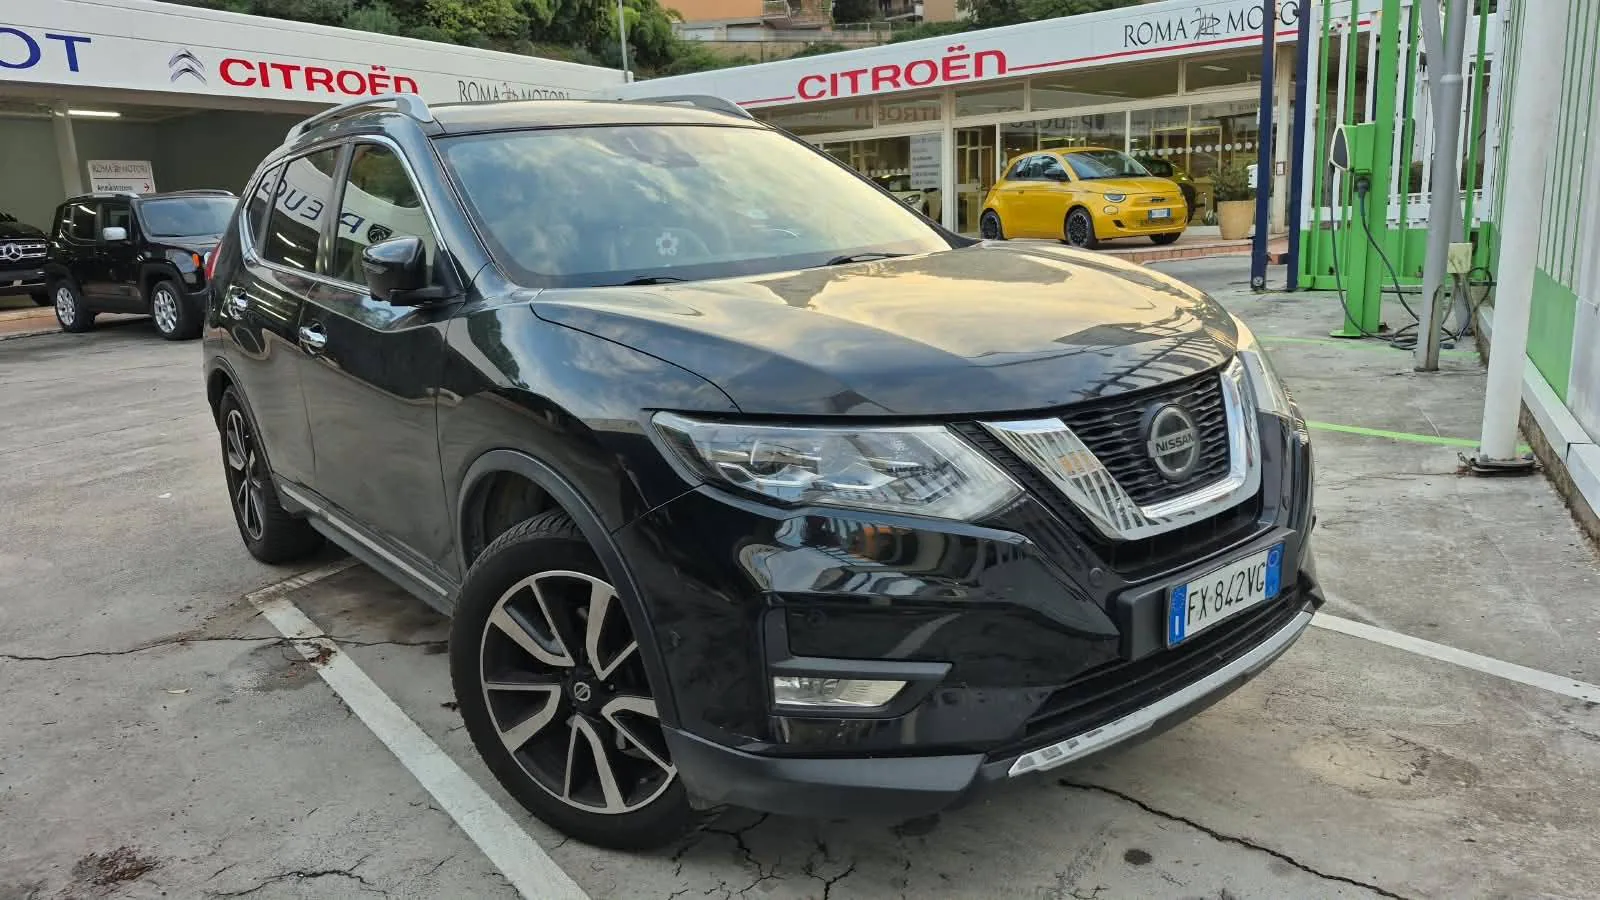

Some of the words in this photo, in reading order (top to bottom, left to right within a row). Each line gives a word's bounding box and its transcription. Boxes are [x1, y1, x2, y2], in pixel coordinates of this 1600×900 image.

[1124, 17, 1187, 47] ROMA
[458, 80, 500, 102] ROMA
[1155, 433, 1194, 455] NISSAN
[1187, 586, 1209, 626] FX
[1214, 562, 1266, 612] 842VG
